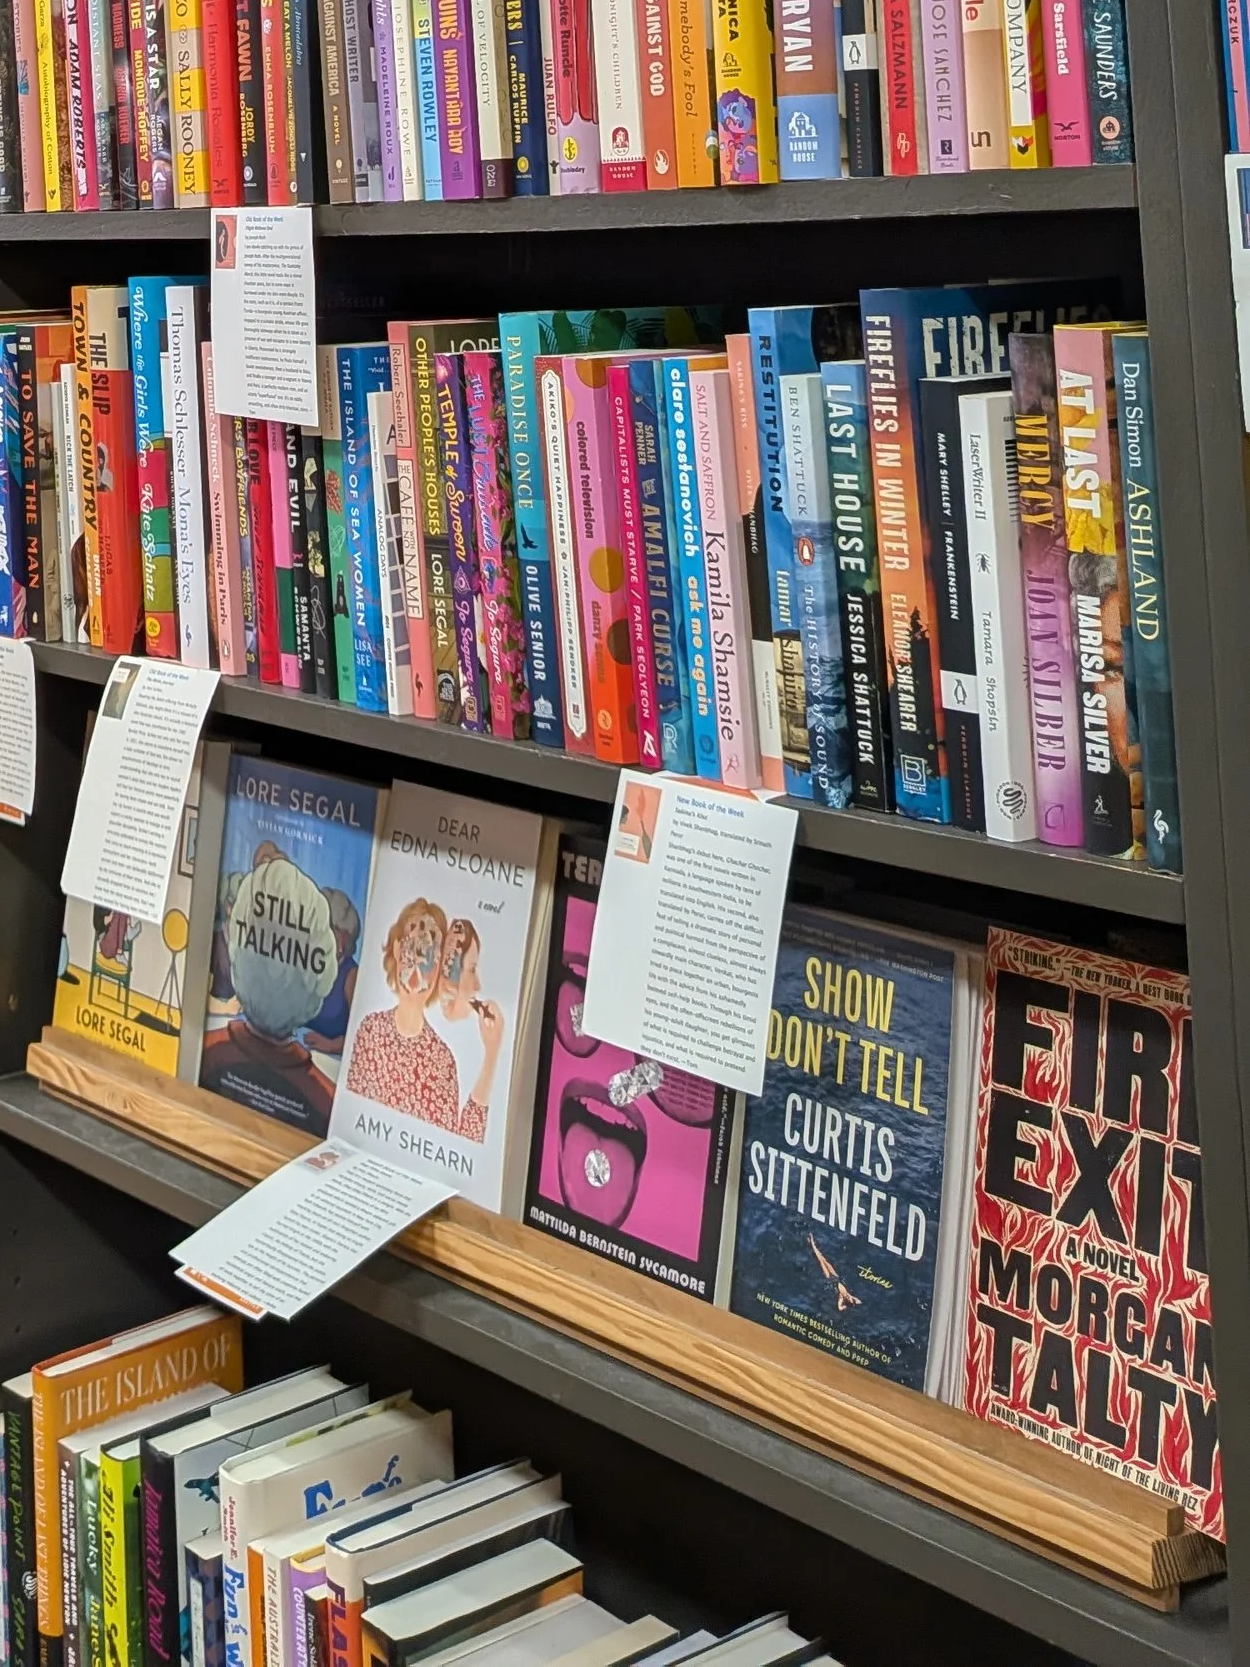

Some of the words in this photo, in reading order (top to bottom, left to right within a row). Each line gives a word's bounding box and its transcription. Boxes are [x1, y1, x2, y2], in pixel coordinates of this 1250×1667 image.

[146, 5, 156, 21] IS
[146, 25, 153, 38] A
[147, 44, 160, 89] STAR
[178, 51, 193, 109] SALLY
[180, 112, 195, 195] ROONEY
[72, 301, 86, 372] TOWN
[169, 307, 183, 387] Thomas
[415, 337, 427, 388] OTHER
[20, 369, 32, 400] TO
[79, 384, 89, 403] &
[506, 335, 527, 448] PARADISE
[866, 315, 898, 432] FIREFLIES
[1060, 368, 1095, 416] AT
[1121, 362, 1140, 400] Dan
[23, 410, 35, 469] SAVE
[174, 390, 187, 477] Schlesser
[420, 393, 433, 466] PEOPLE'S
[759, 335, 782, 512] RESTITUTION
[826, 384, 856, 458] LAST
[1124, 405, 1143, 468] Simon
[77, 414, 96, 530] COUNTRY
[514, 452, 533, 510] ONCE
[876, 443, 901, 468] IN
[1015, 414, 1055, 530] MERCY
[1064, 426, 1101, 518] LAST
[25, 479, 37, 525] THE
[179, 485, 191, 548] Mona's
[426, 470, 440, 535] HOUSES
[834, 474, 866, 574] HOUSE
[877, 475, 909, 571] WINTER
[27, 537, 39, 589] MAN
[181, 555, 192, 604] Eyes
[1127, 478, 1160, 641] ASHLAND
[236, 777, 281, 805] LORE
[288, 789, 361, 828] SEGAL
[437, 817, 481, 844] DEAR
[677, 796, 690, 805] New
[692, 799, 707, 809] Book
[707, 802, 715, 811] of
[716, 805, 726, 813] the
[728, 807, 744, 818] Week
[391, 831, 441, 863] EDNA
[445, 844, 525, 888] SLOANE
[252, 891, 313, 931] STILL
[235, 920, 327, 974] TALKING
[803, 958, 896, 1032] SHOW
[765, 1008, 851, 1084] DON'T
[856, 1037, 930, 1115] TELL
[354, 1112, 393, 1142] AMY
[399, 1129, 475, 1175] SHEARN
[783, 1094, 896, 1182] CURTIS
[748, 1142, 927, 1262] SITTENFELD
[530, 1205, 576, 1239] MATTILDA
[579, 1228, 636, 1265] BERNSTEIN
[638, 1255, 706, 1294] SYCAMORE
[1066, 1239, 1080, 1261] A
[1084, 1243, 1138, 1283] NOVEL
[61, 1377, 108, 1425] THE
[116, 1347, 197, 1405] ISLAND
[203, 1333, 230, 1371] OF
[978, 1303, 1217, 1488] TALTY
[991, 1403, 1049, 1440] AWARD-WINNING
[1052, 1434, 1081, 1456] AUTHOR
[1084, 1445, 1094, 1460] OF
[1096, 1450, 1119, 1472] NIGHT
[1122, 1464, 1132, 1479] OF
[1136, 1469, 1149, 1487] THE
[1153, 1478, 1180, 1502] LIVING
[1182, 1492, 1198, 1511] REZ
